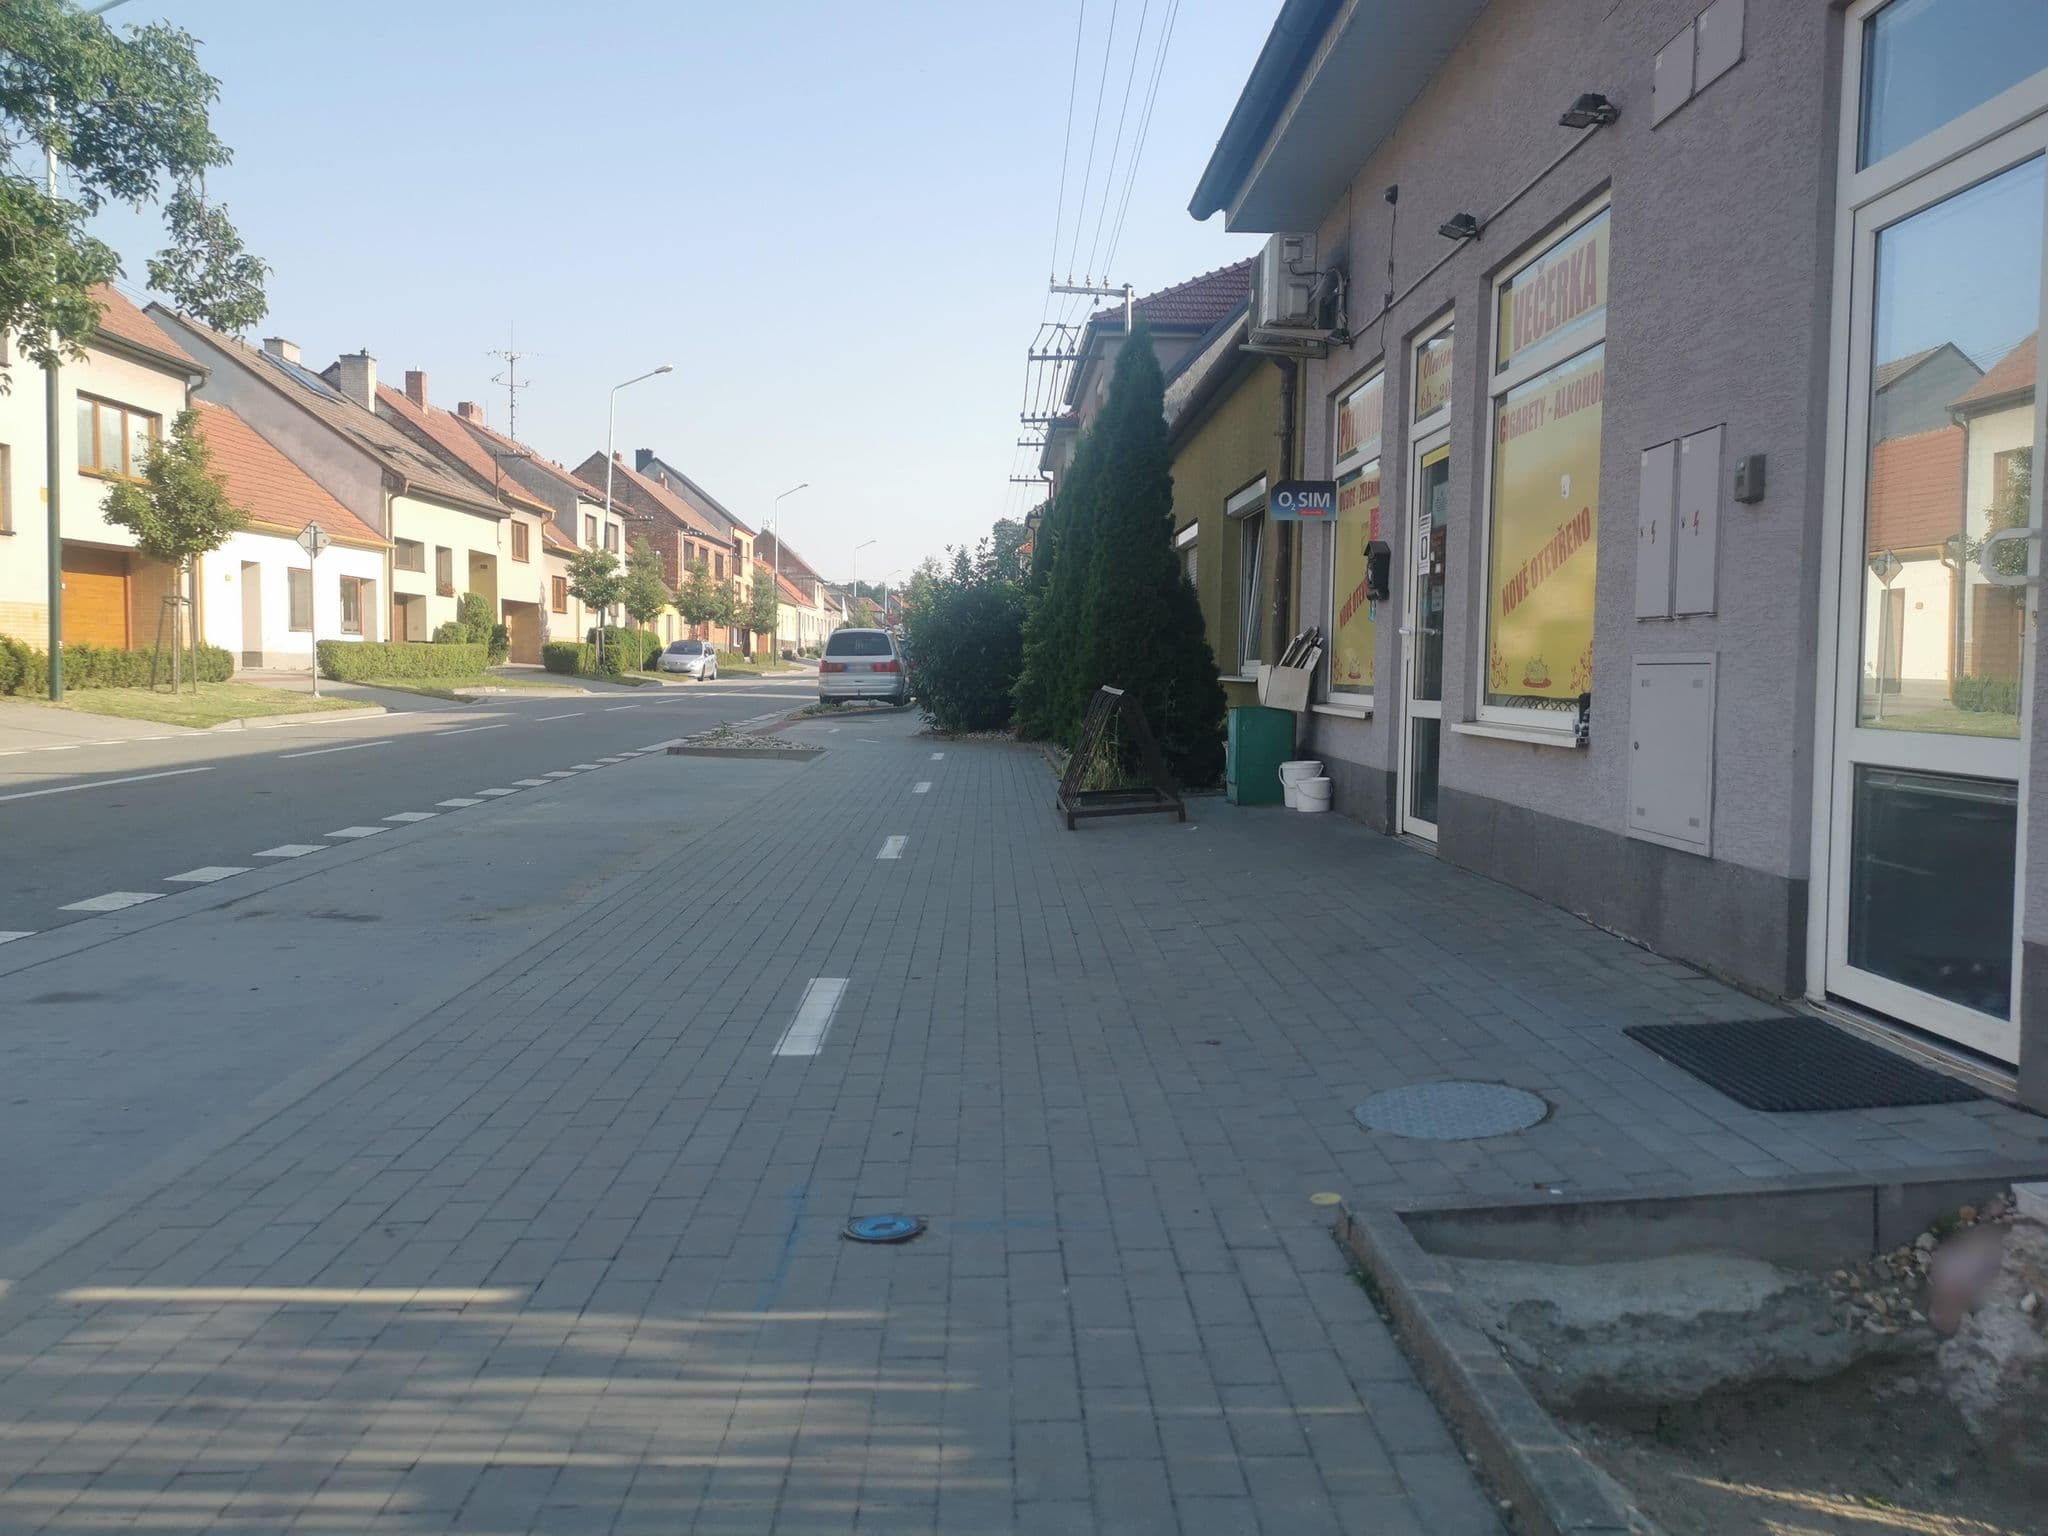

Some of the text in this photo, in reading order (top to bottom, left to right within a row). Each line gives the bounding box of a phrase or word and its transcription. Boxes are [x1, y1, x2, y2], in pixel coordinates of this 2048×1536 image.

[1512, 239, 1597, 351] VEČERKA
[1499, 395, 1546, 444] CIGARETY
[1298, 492, 1330, 508] SIM
[1502, 506, 1591, 617] NOVĚ OTEVŘENO
